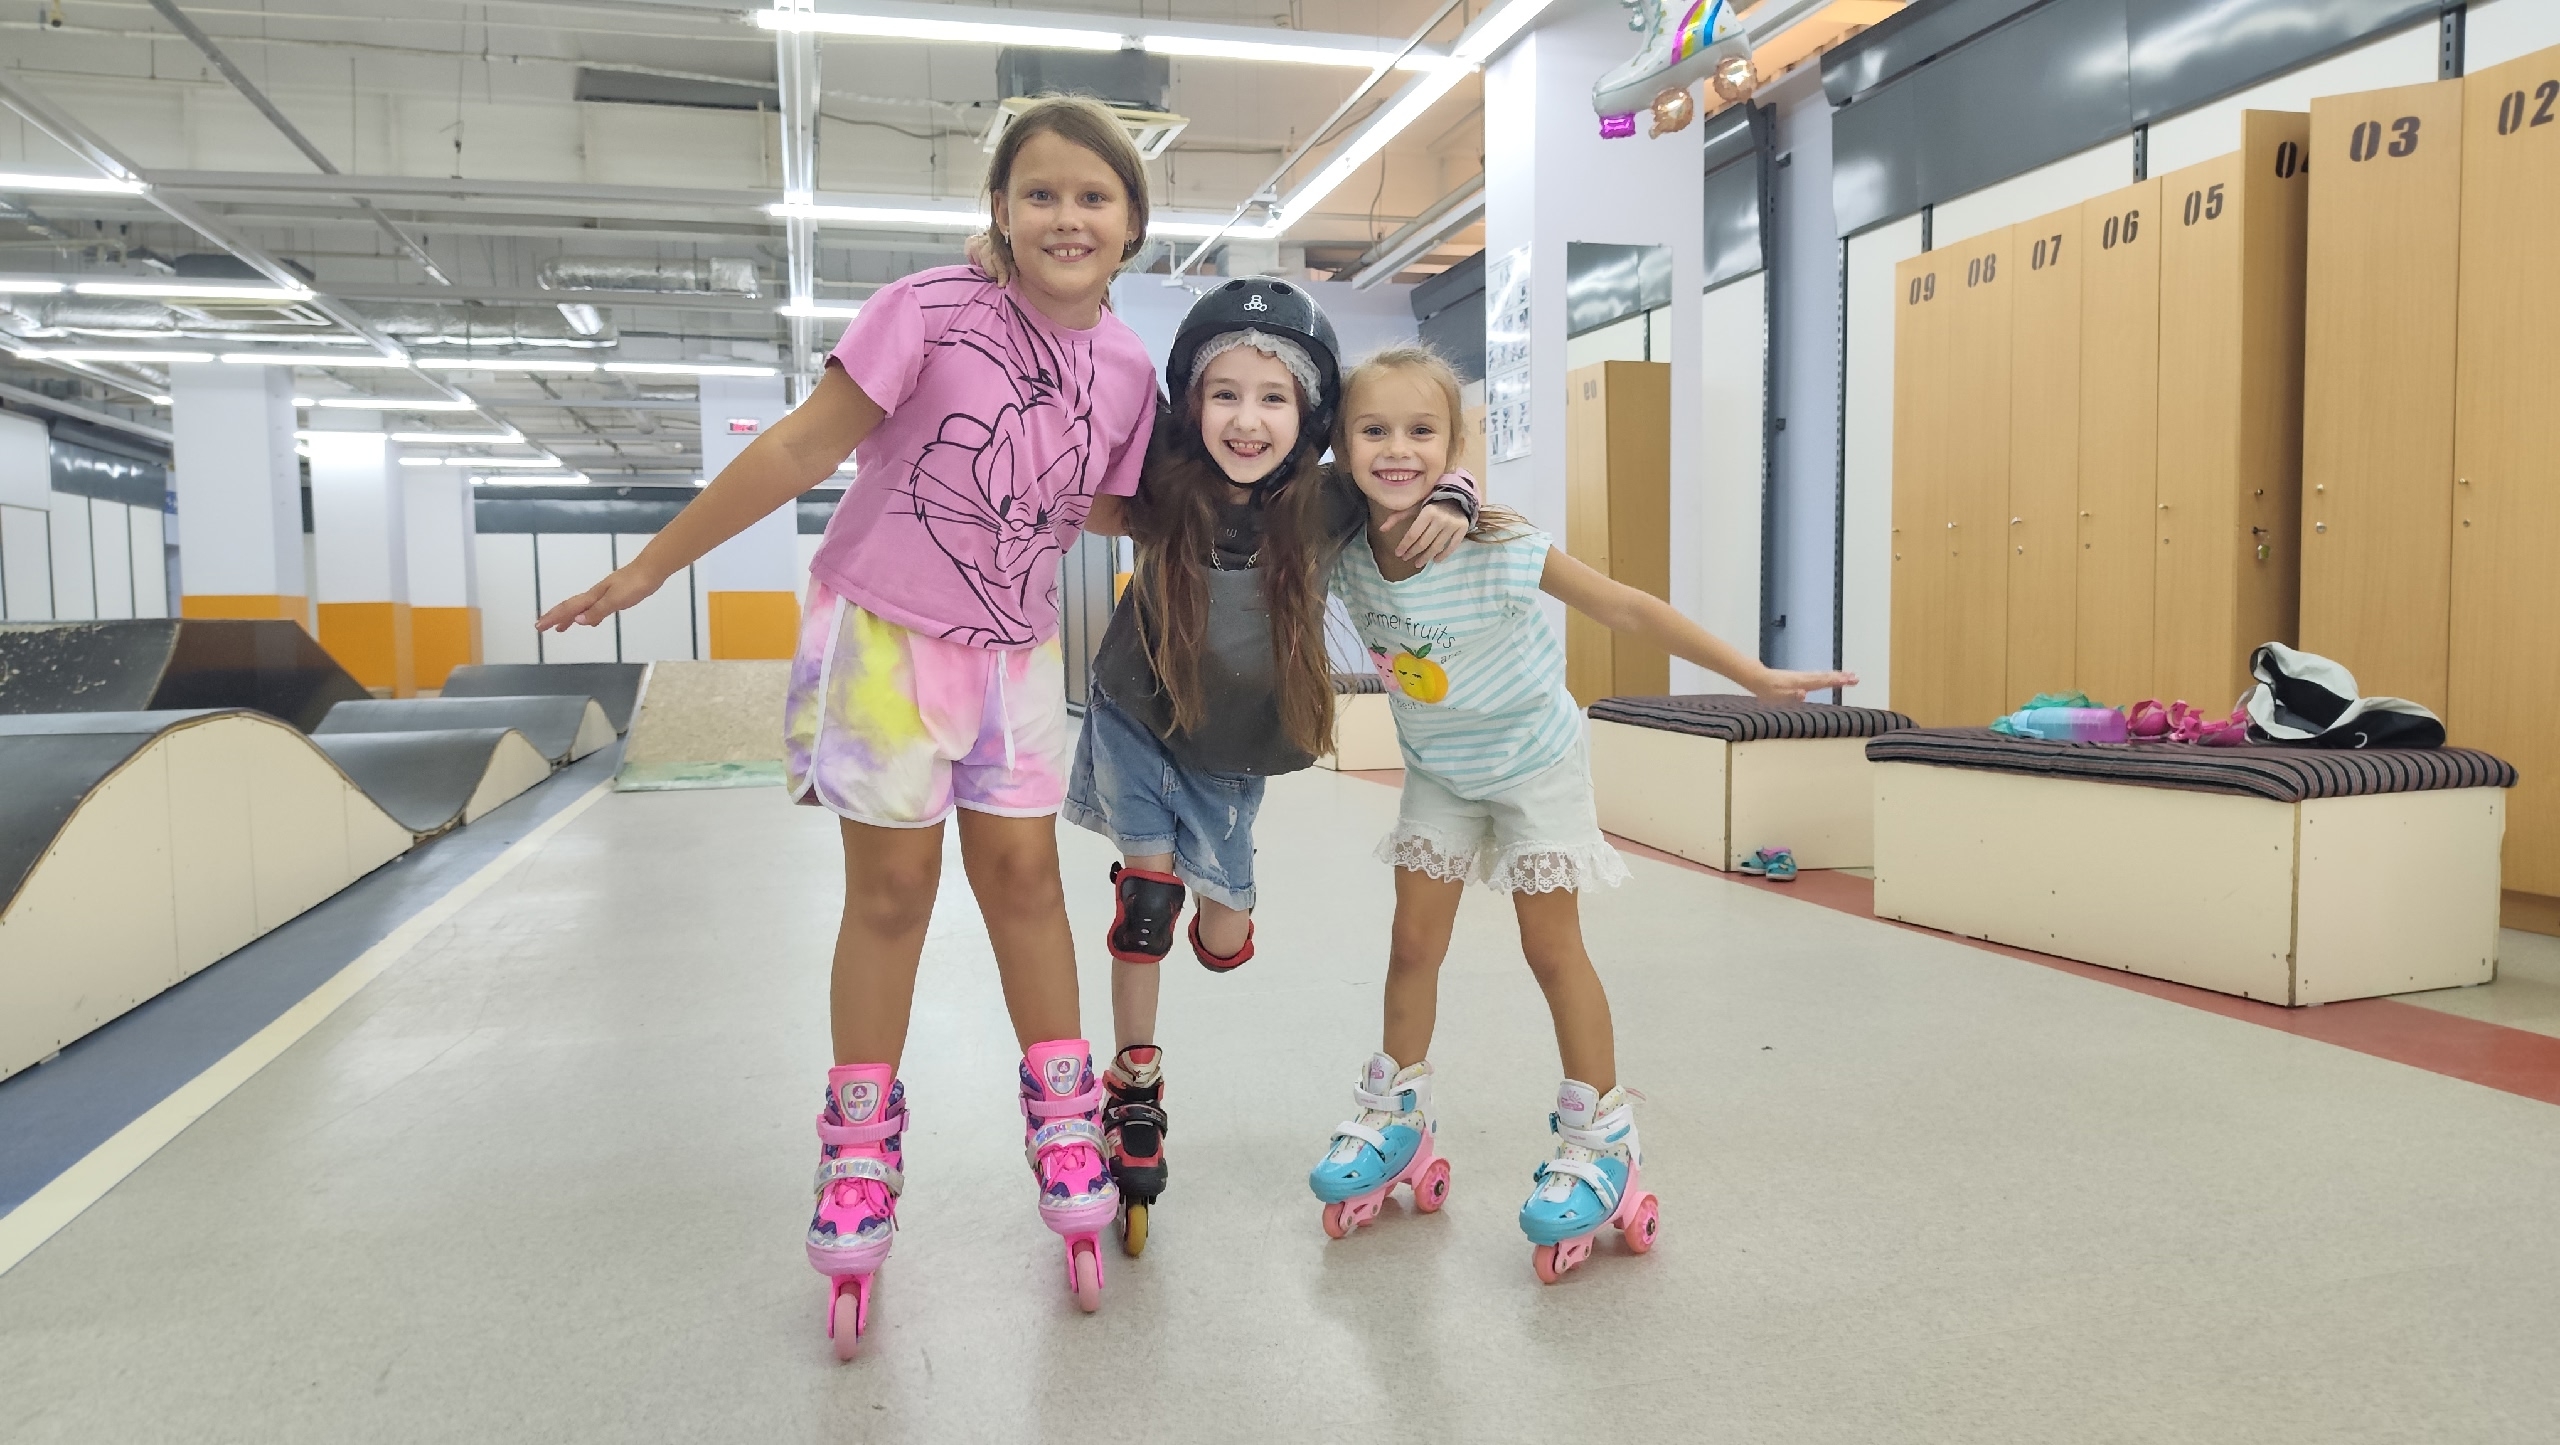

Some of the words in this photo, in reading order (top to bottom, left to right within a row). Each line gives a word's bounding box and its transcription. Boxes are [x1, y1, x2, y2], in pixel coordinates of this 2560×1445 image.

[2498, 80, 2560, 135] 02
[2350, 116, 2421, 162] 03
[2184, 183, 2224, 226] 05
[2103, 210, 2139, 249] 06
[1968, 253, 1996, 288] 08
[2032, 234, 2062, 270] 07
[1909, 273, 1936, 305] 09
[1404, 617, 1456, 648] fruits
